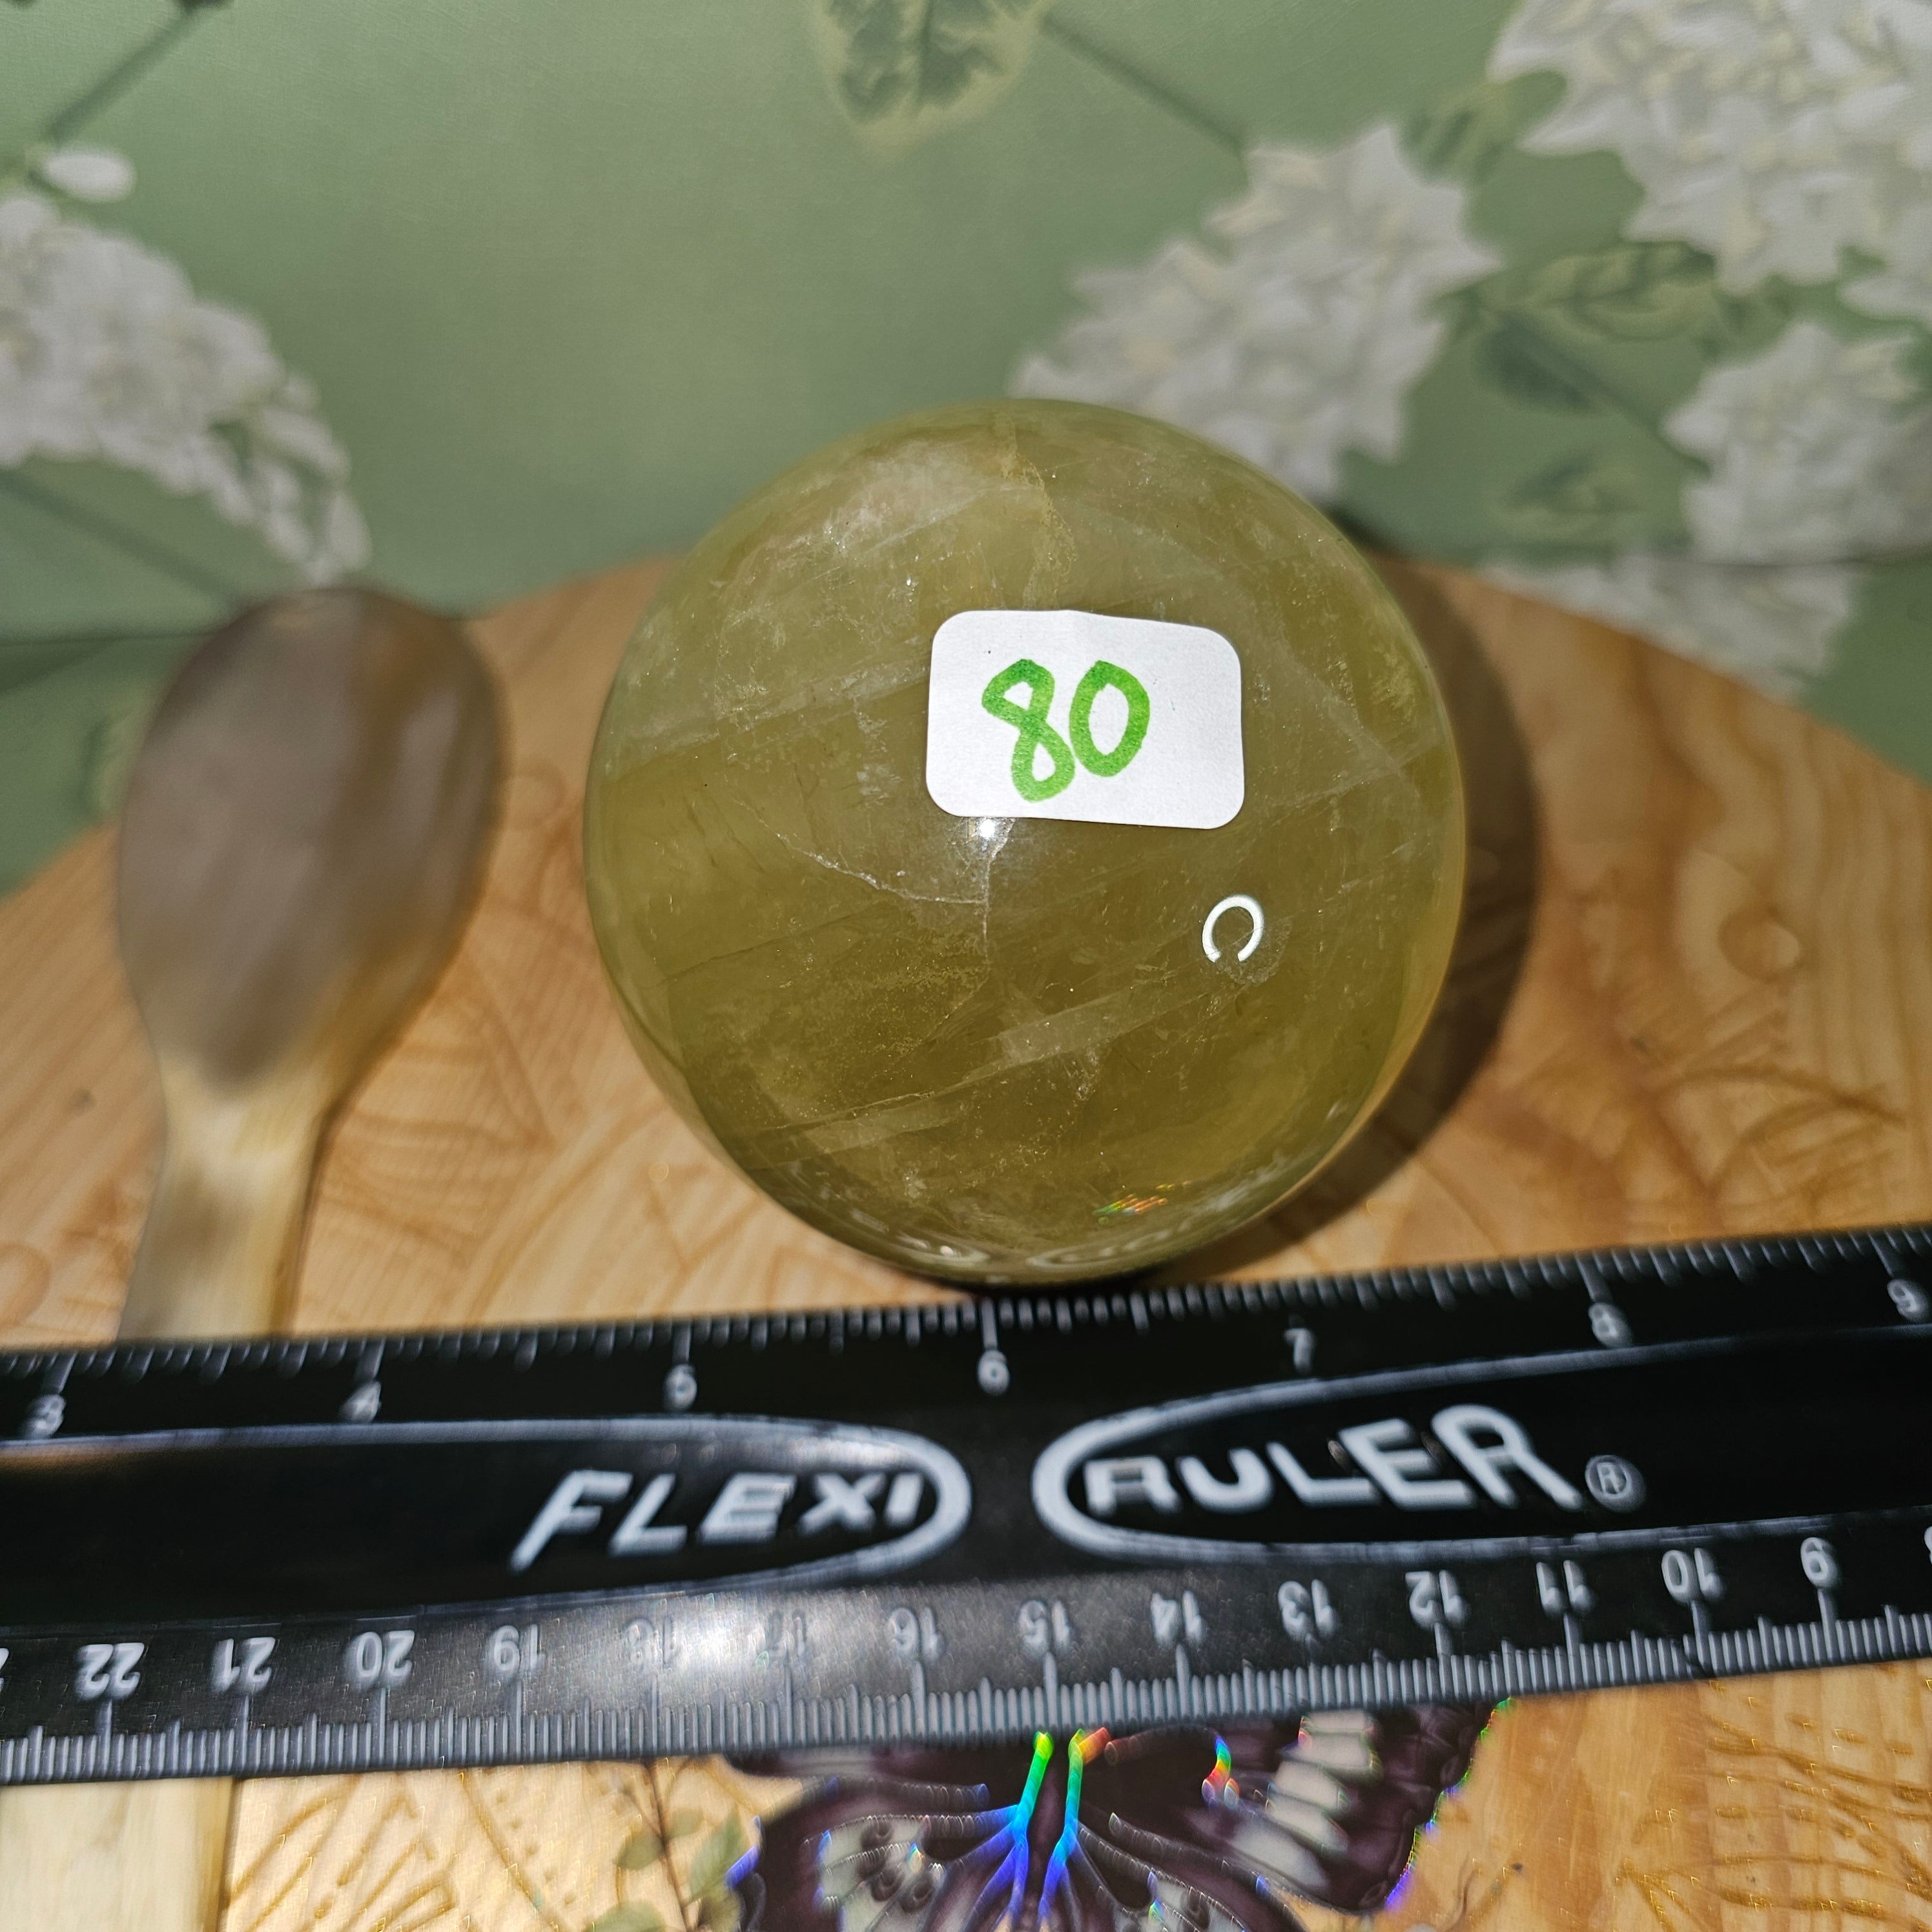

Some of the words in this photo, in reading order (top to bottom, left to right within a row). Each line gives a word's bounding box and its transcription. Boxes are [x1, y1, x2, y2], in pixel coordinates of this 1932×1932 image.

[981, 658, 1150, 803] 80
[26, 1393, 66, 1439] 3
[340, 1381, 381, 1421] 4
[978, 1349, 1010, 1395] 6
[1285, 1326, 1315, 1373] 7
[1588, 1301, 1633, 1349] 8
[1887, 1278, 1932, 1324] 9
[510, 1470, 925, 1573] FLEXI
[1083, 1403, 1583, 1512] RULER
[1404, 1570, 1469, 1627] 12
[1536, 1559, 1598, 1616] 11
[1661, 1548, 1726, 1605] 10
[888, 1607, 943, 1661] 16
[1017, 1599, 1073, 1653] 15
[1149, 1590, 1207, 1649] 14
[1278, 1579, 1339, 1643] 13
[73, 1642, 145, 1700] 22
[210, 1636, 276, 1693] 21
[345, 1630, 415, 1690] 20
[486, 1624, 546, 1674] 19
